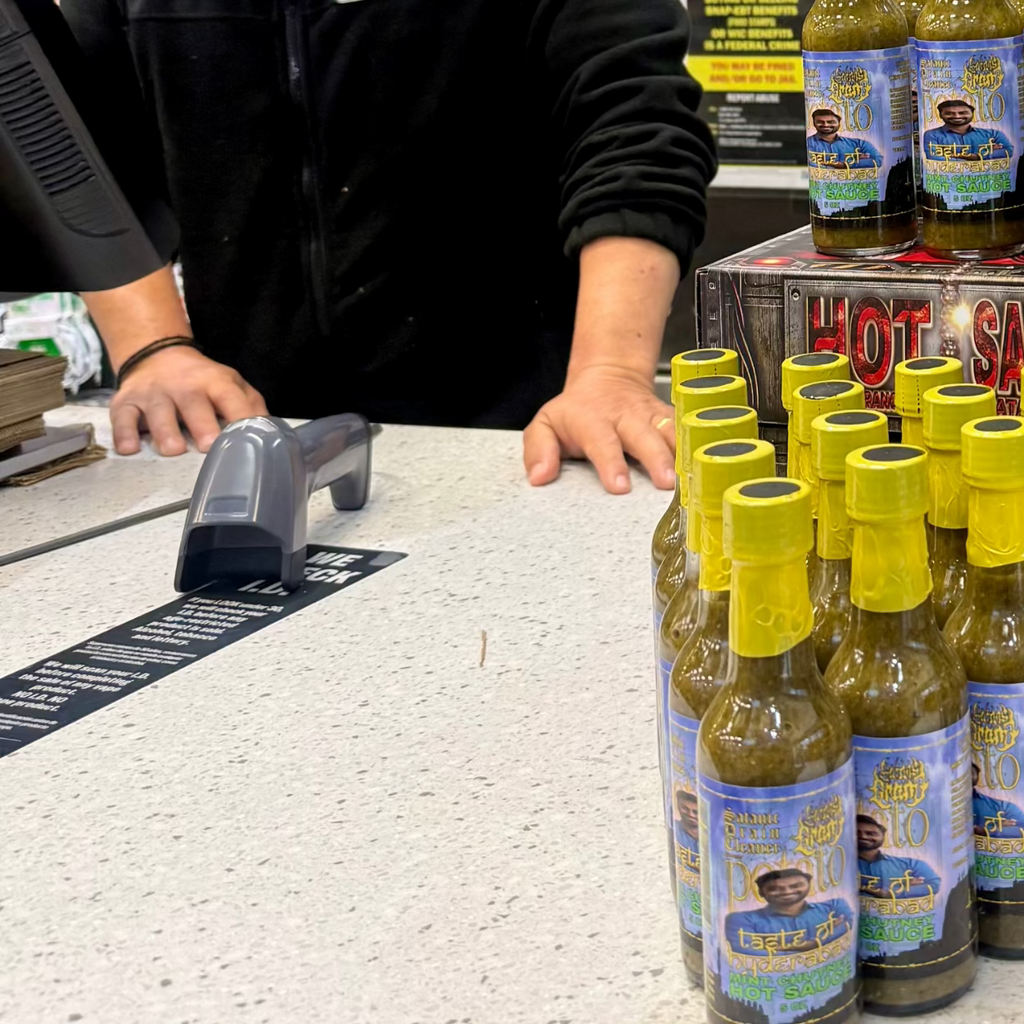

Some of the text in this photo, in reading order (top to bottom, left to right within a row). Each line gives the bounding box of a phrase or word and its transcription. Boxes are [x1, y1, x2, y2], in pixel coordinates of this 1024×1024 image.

[957, 181, 1011, 194] SAUCE
[807, 296, 933, 388] HOT
[306, 551, 363, 568] WE
[724, 808, 779, 825] Satanic
[738, 911, 837, 951] taste of
[861, 925, 935, 942] SAUCE
[730, 972, 774, 986] MINT
[730, 966, 853, 1001] HOT SAUCE
